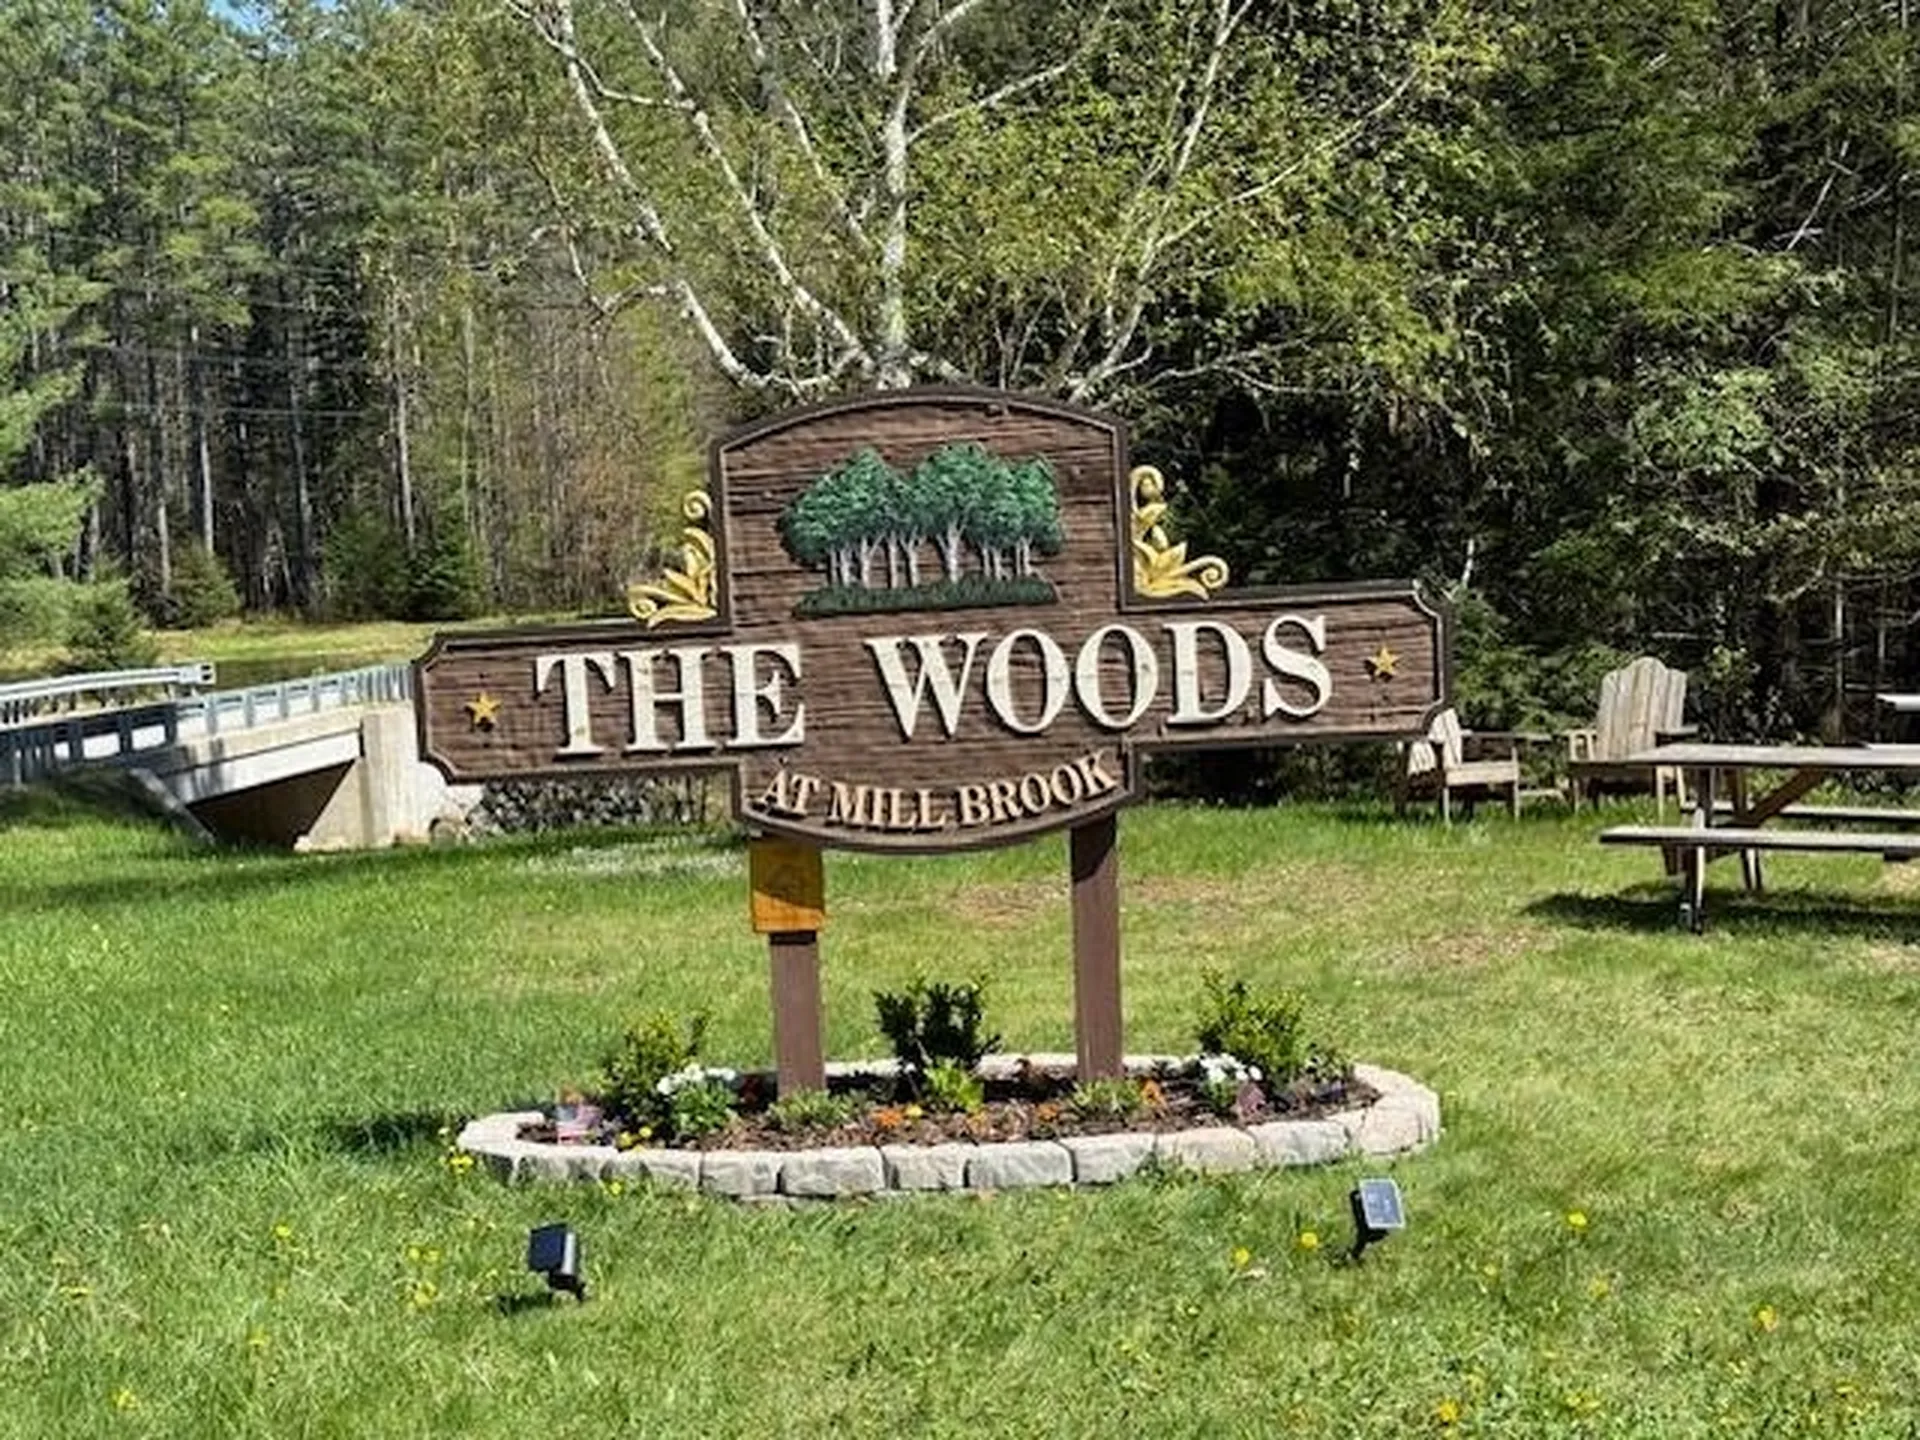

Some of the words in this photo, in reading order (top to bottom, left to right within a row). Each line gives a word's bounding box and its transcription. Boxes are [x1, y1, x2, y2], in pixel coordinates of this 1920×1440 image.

[535, 642, 805, 757] THE
[865, 613, 1333, 739] WOODS
[759, 769, 820, 815] AT
[828, 781, 947, 829] MILL
[956, 750, 1119, 826] BROOK
